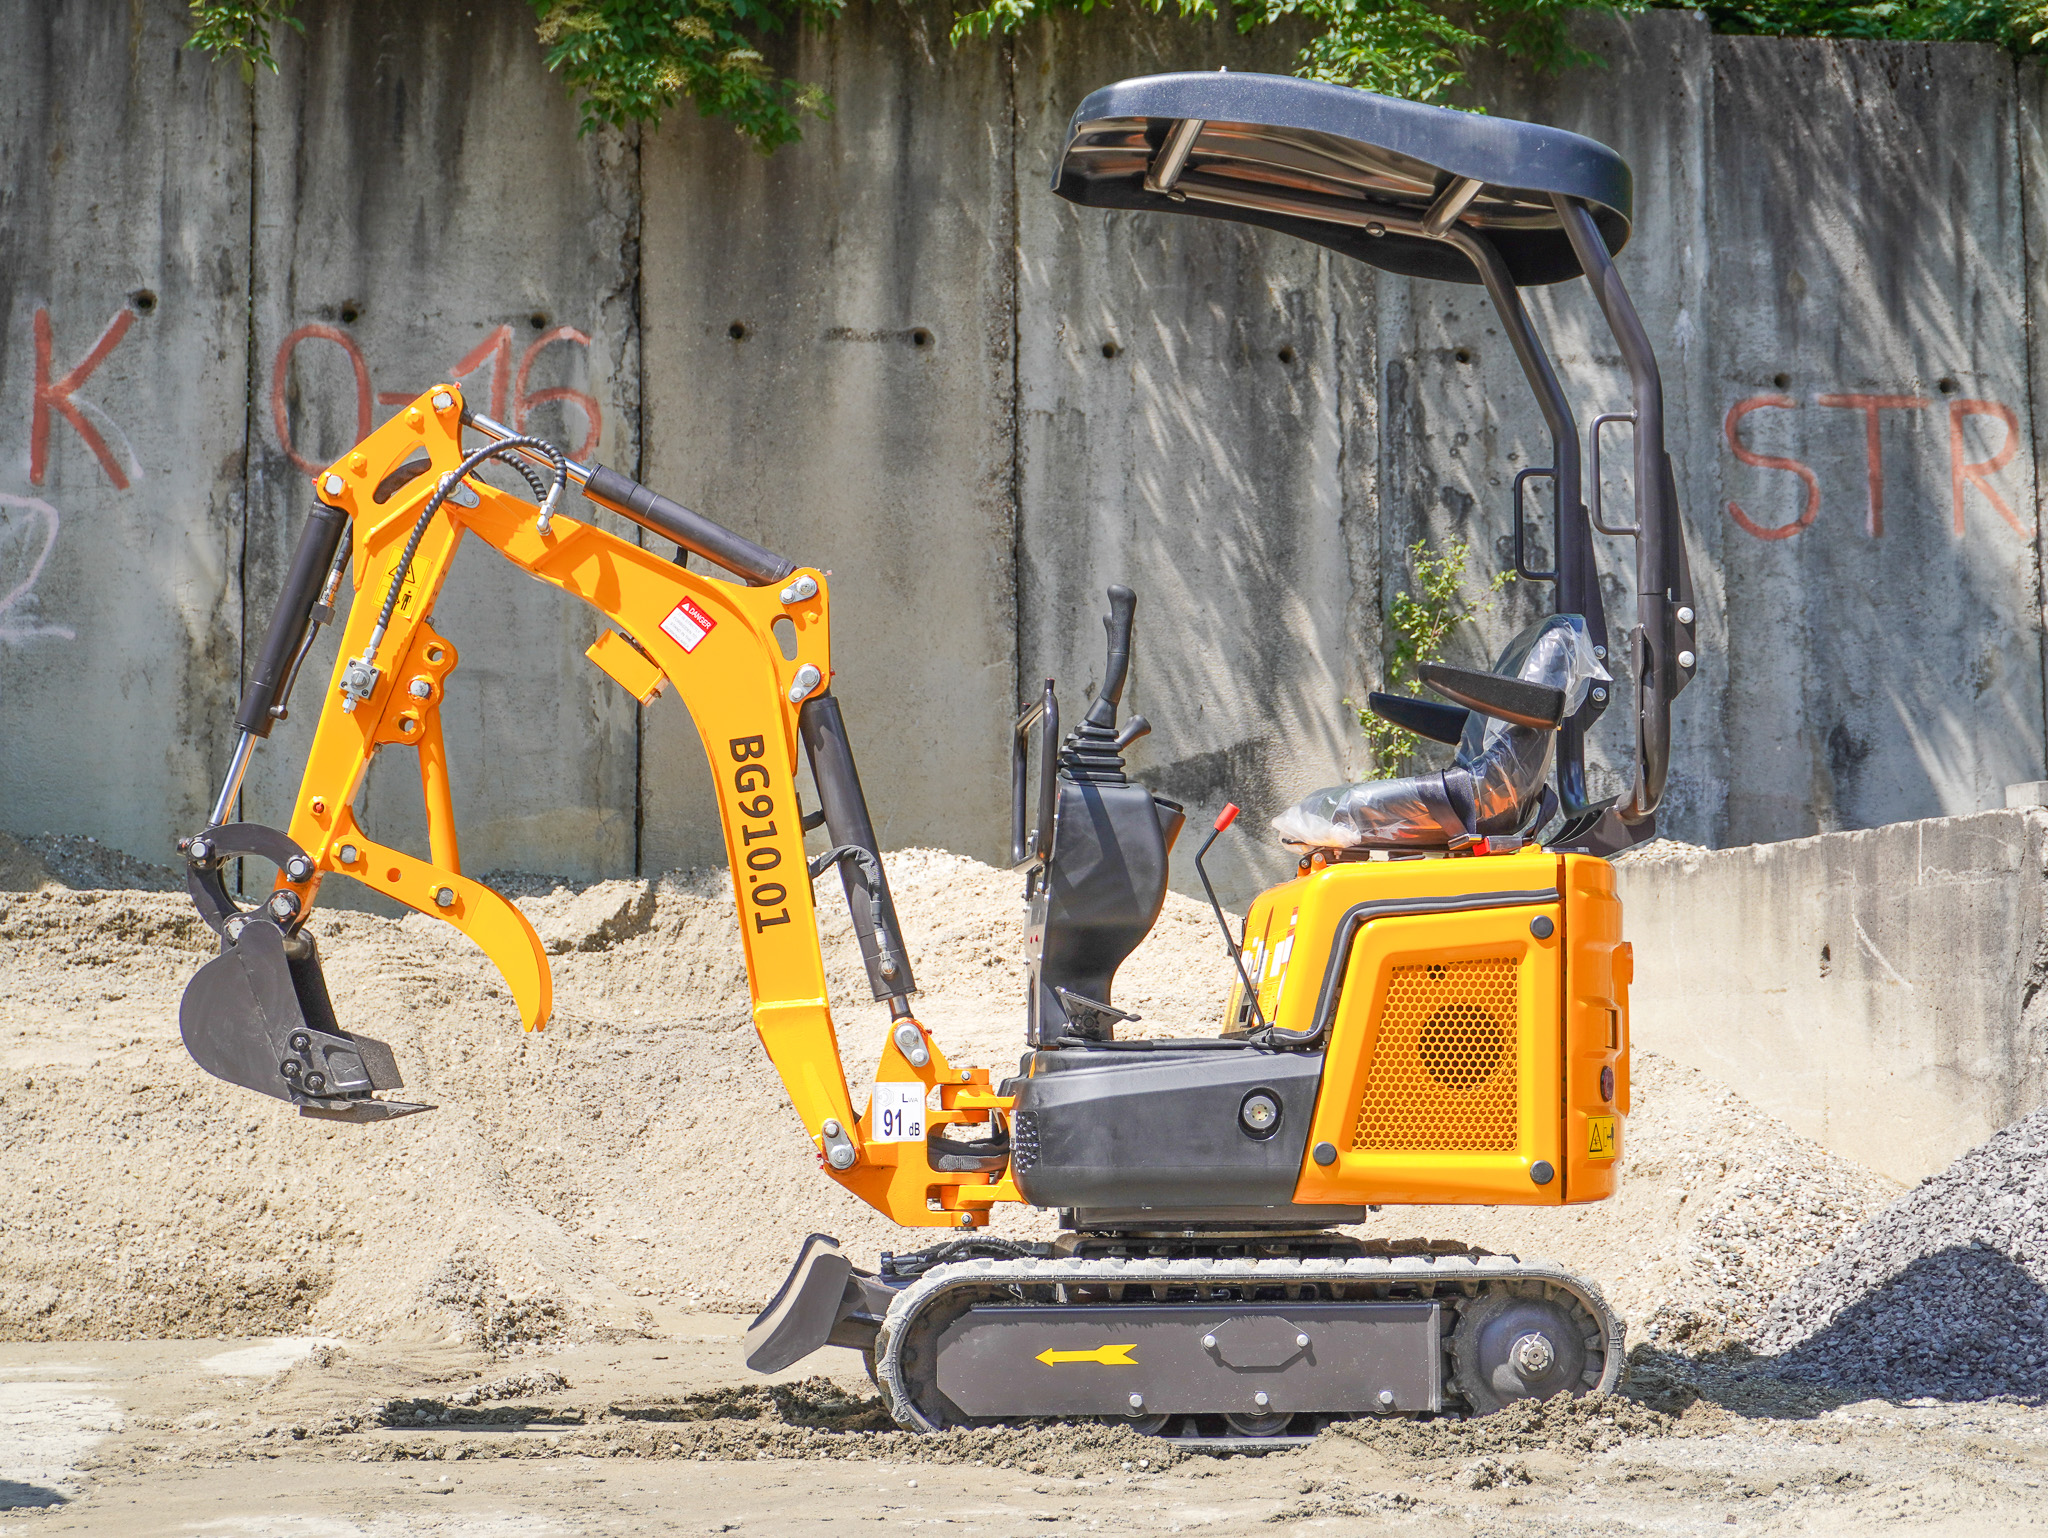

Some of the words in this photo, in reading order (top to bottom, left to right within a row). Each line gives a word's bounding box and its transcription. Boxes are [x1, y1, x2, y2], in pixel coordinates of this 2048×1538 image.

[29, 306, 134, 489] K
[1724, 393, 2032, 541] STR
[688, 607, 712, 629] DANGER
[729, 734, 791, 934] BG910.01
[883, 1108, 902, 1136] 91
[908, 1122, 921, 1136] dB
